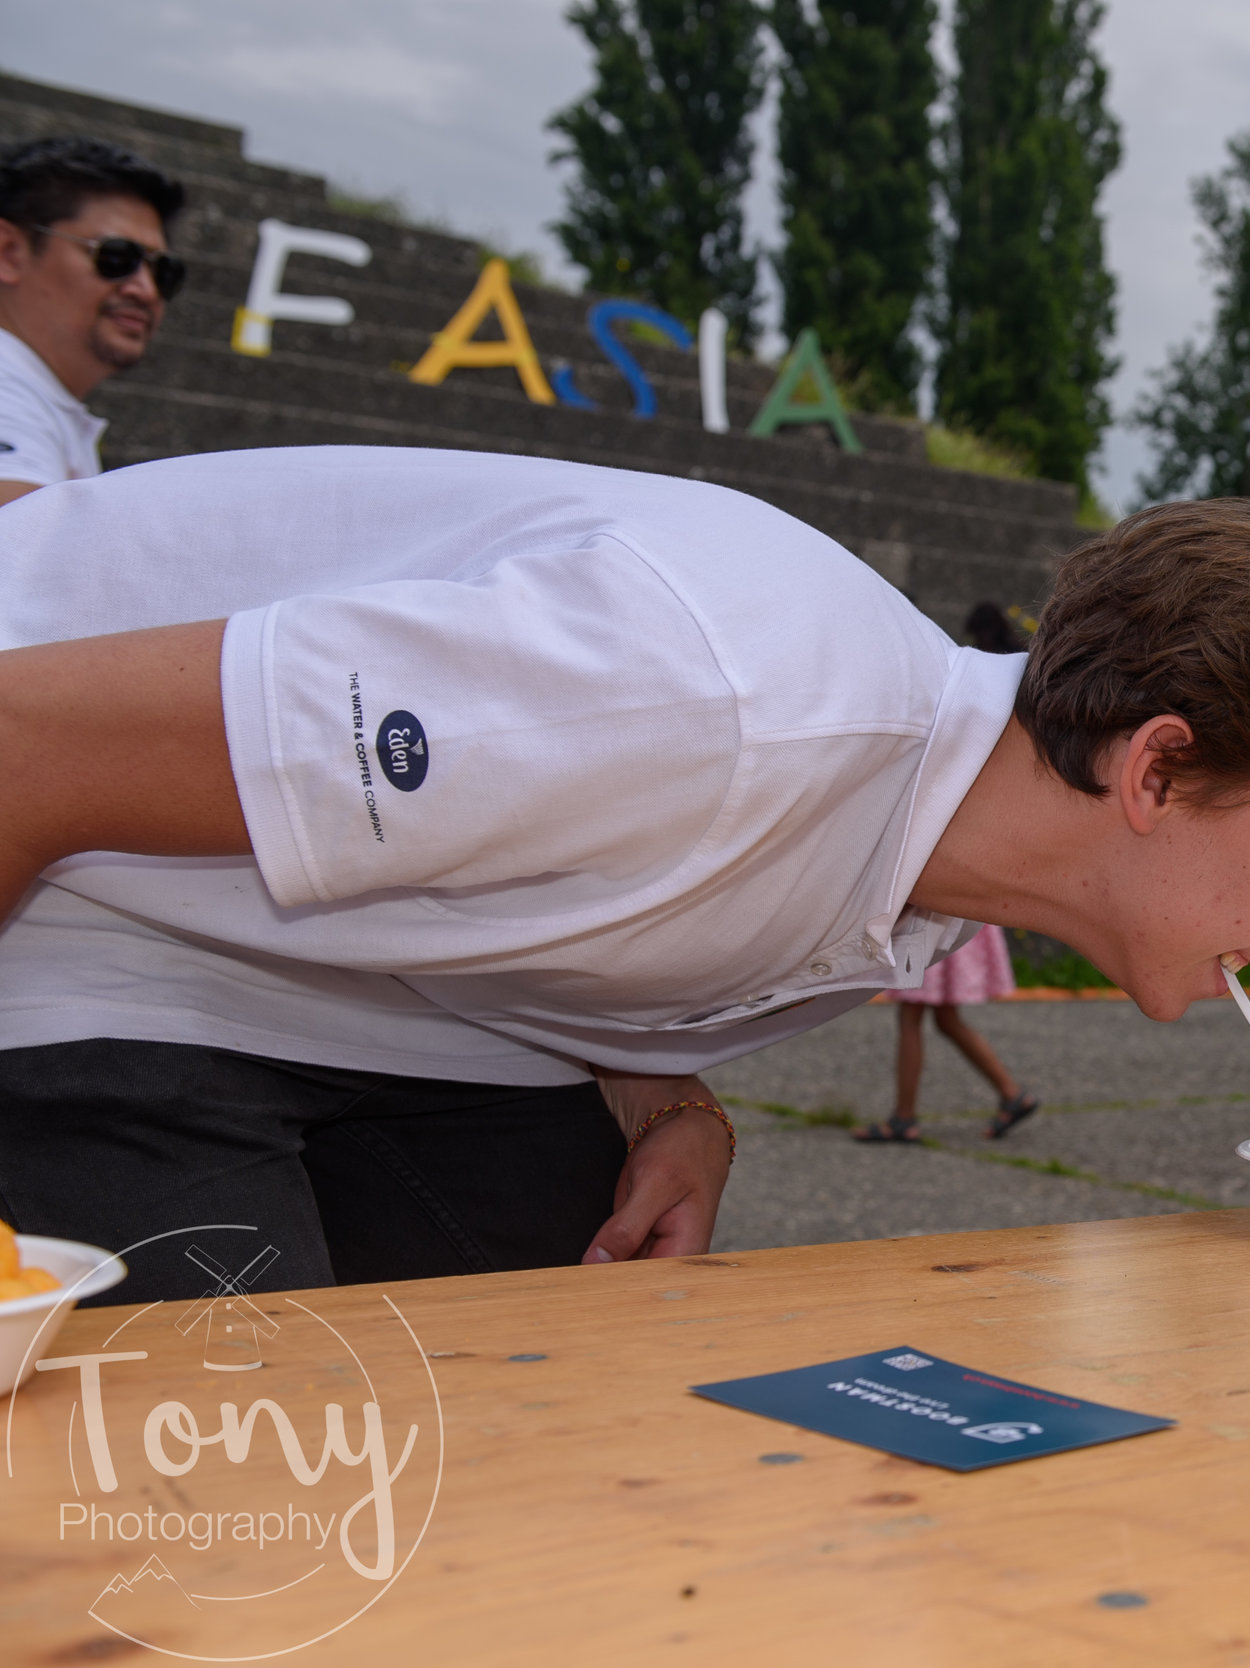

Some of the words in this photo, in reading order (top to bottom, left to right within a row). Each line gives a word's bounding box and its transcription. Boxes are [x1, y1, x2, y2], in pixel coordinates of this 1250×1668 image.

[349, 672, 360, 691] THE
[351, 693, 363, 729] WATER
[354, 732, 364, 740] &
[388, 727, 411, 773] Eden
[355, 742, 373, 787] COFFEE
[364, 790, 385, 843] COMPANY
[826, 1382, 970, 1425] BOOSTMAN
